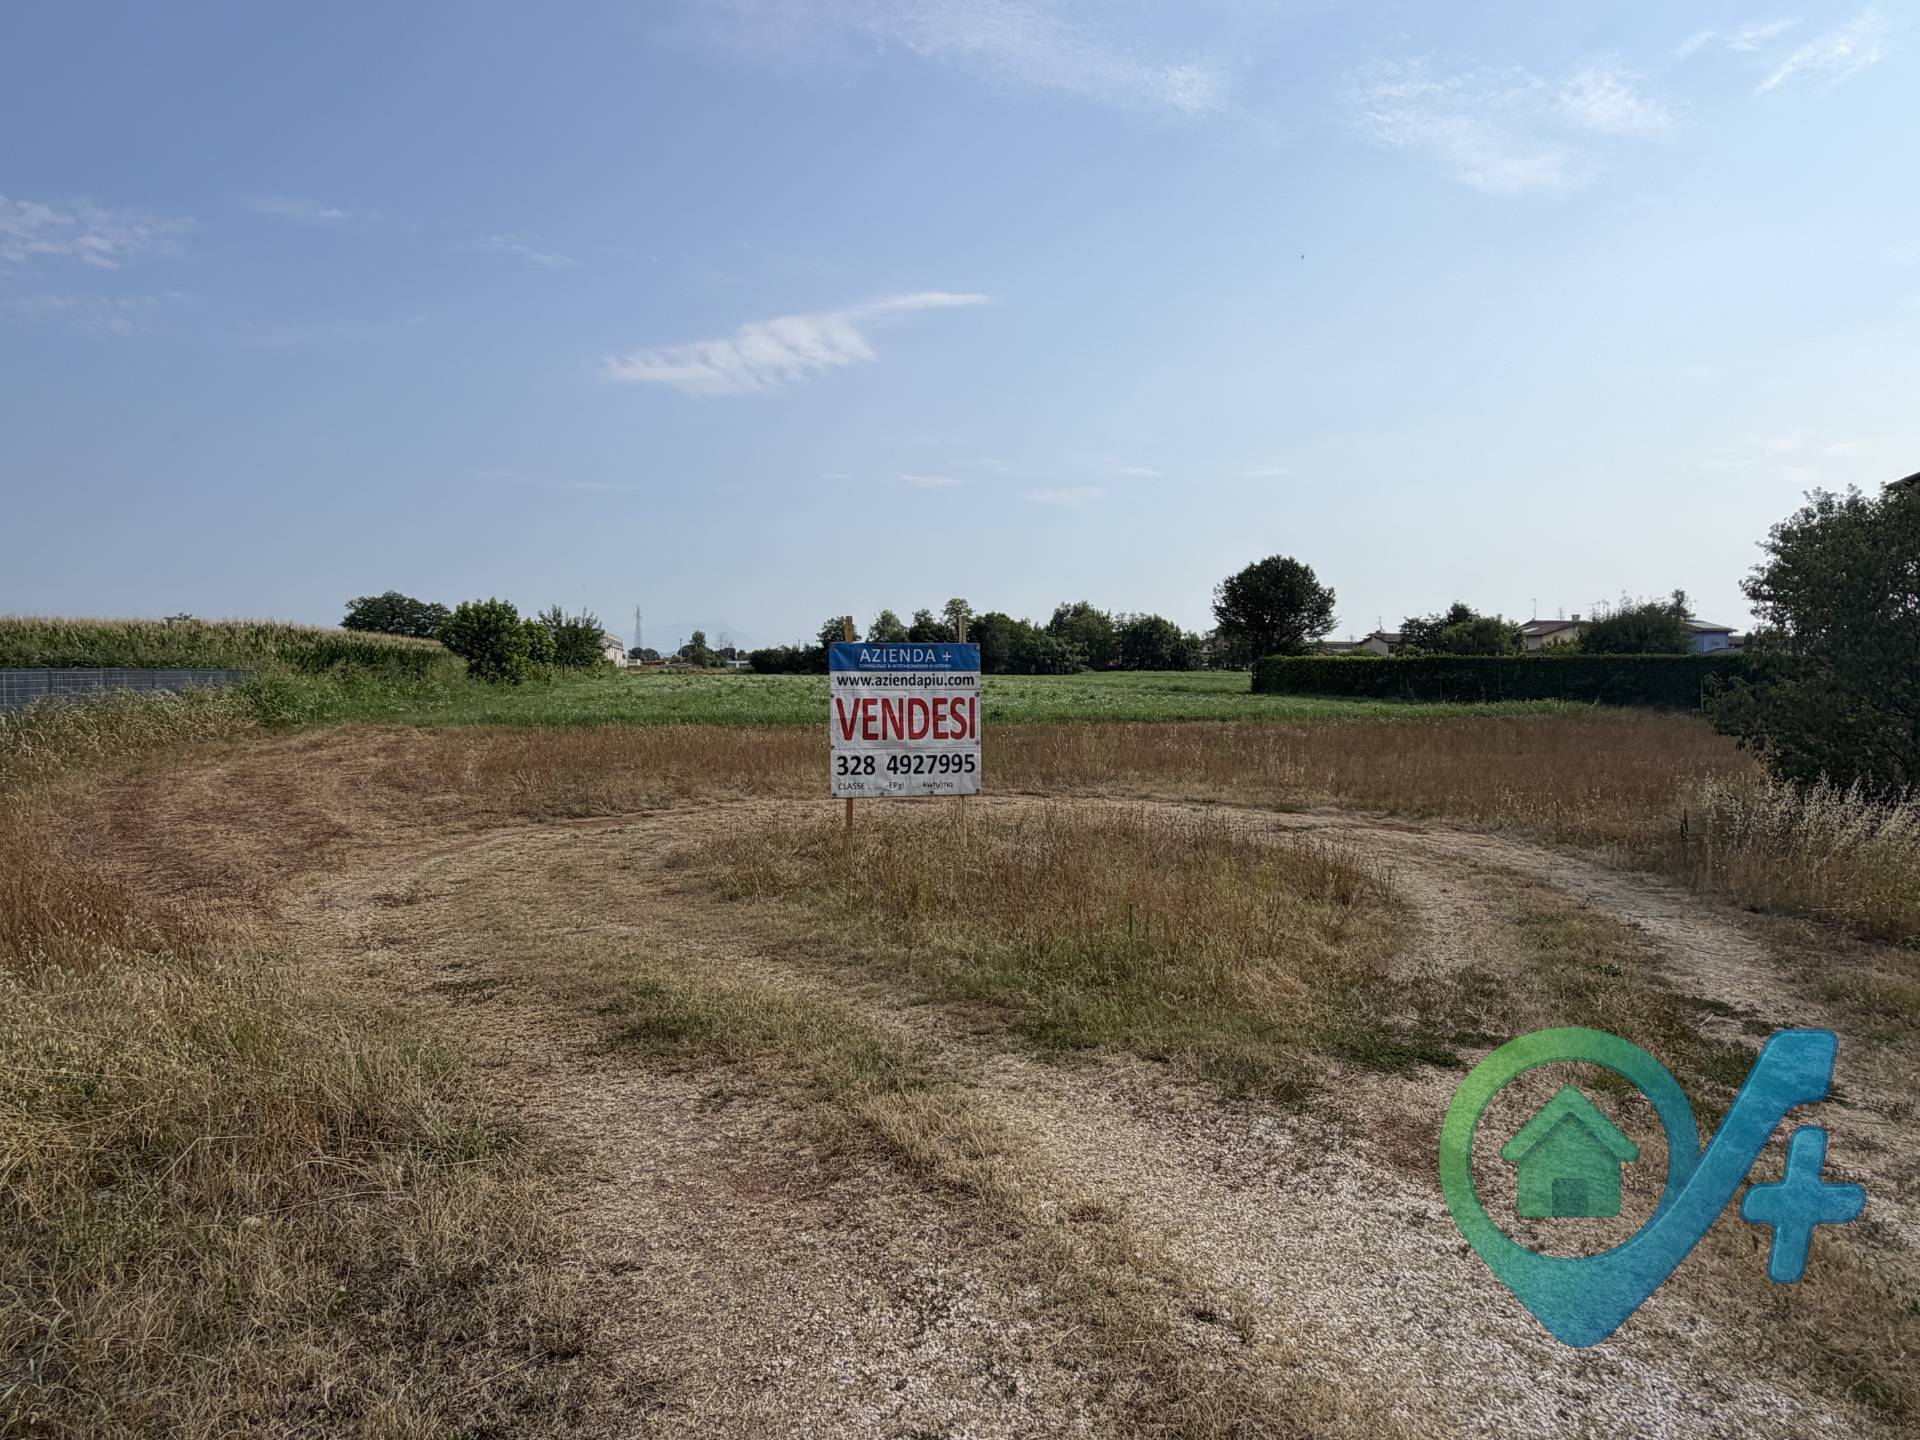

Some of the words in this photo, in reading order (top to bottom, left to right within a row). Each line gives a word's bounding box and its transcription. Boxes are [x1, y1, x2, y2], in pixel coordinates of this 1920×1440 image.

[859, 649, 936, 663] AZIENDA
[837, 673, 975, 689] www.aziendapiu.com
[835, 697, 976, 741] VENDESI
[836, 755, 876, 776] 328
[886, 753, 976, 775] 4927995
[838, 782, 865, 790] CLASSE
